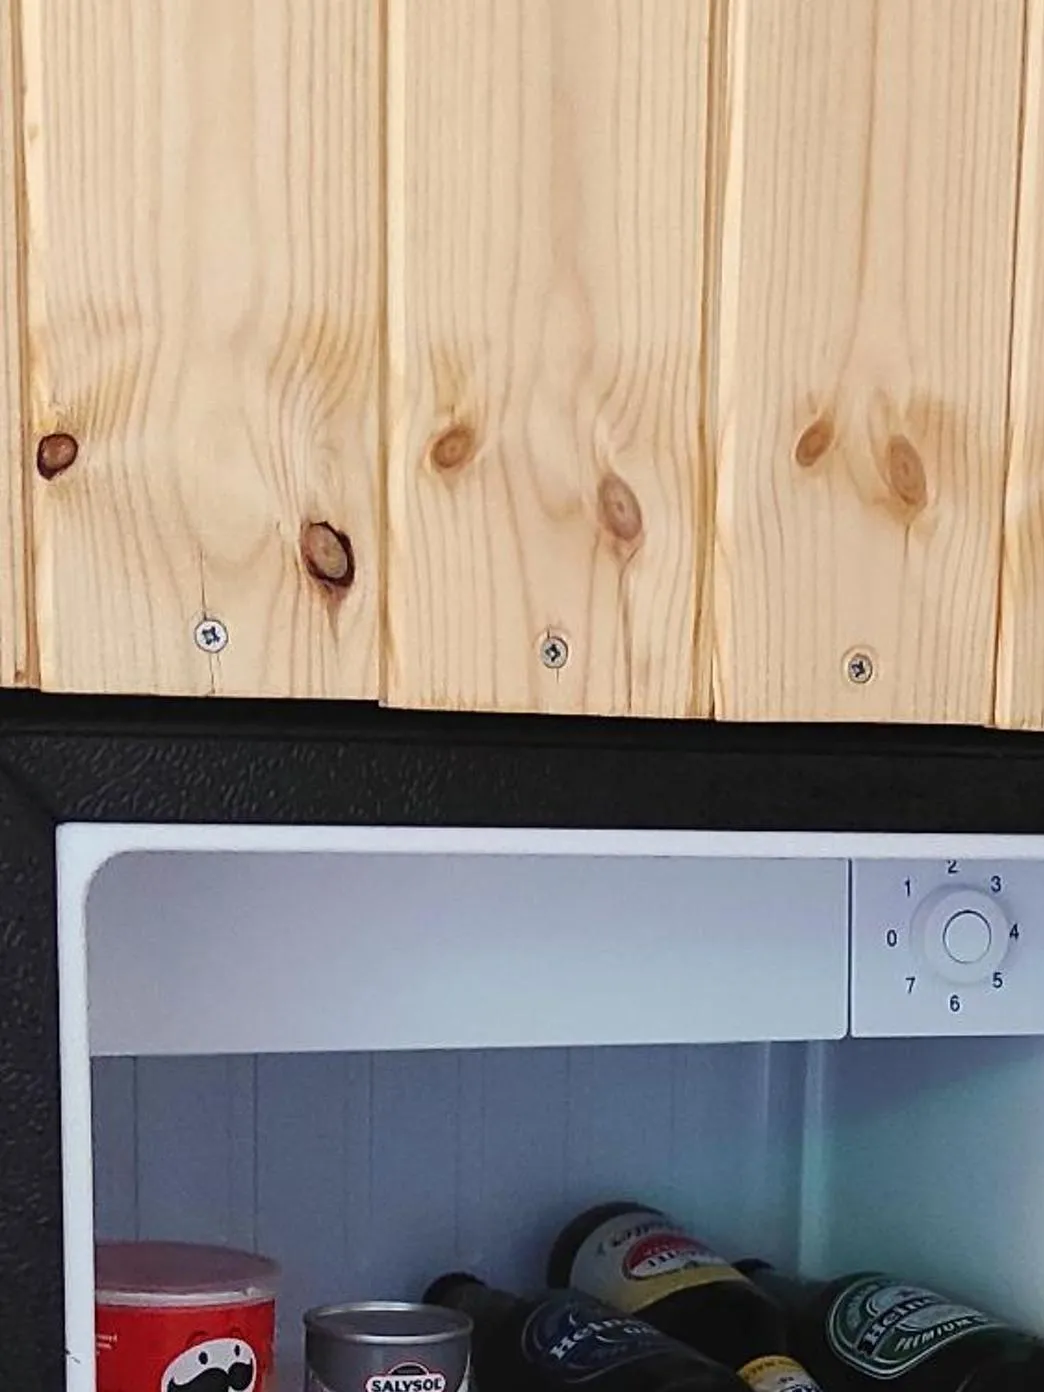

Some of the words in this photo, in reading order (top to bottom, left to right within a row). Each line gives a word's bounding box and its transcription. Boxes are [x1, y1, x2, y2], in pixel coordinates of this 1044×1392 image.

[947, 859, 958, 874] 2
[904, 879, 912, 897] 1
[990, 875, 1001, 893] 3
[886, 929, 898, 947] 0
[1009, 923, 1020, 940] 4
[905, 976, 916, 994] 7
[992, 971, 1003, 989] 5
[949, 994, 960, 1012] 6
[371, 1377, 442, 1392] SALYSOL
